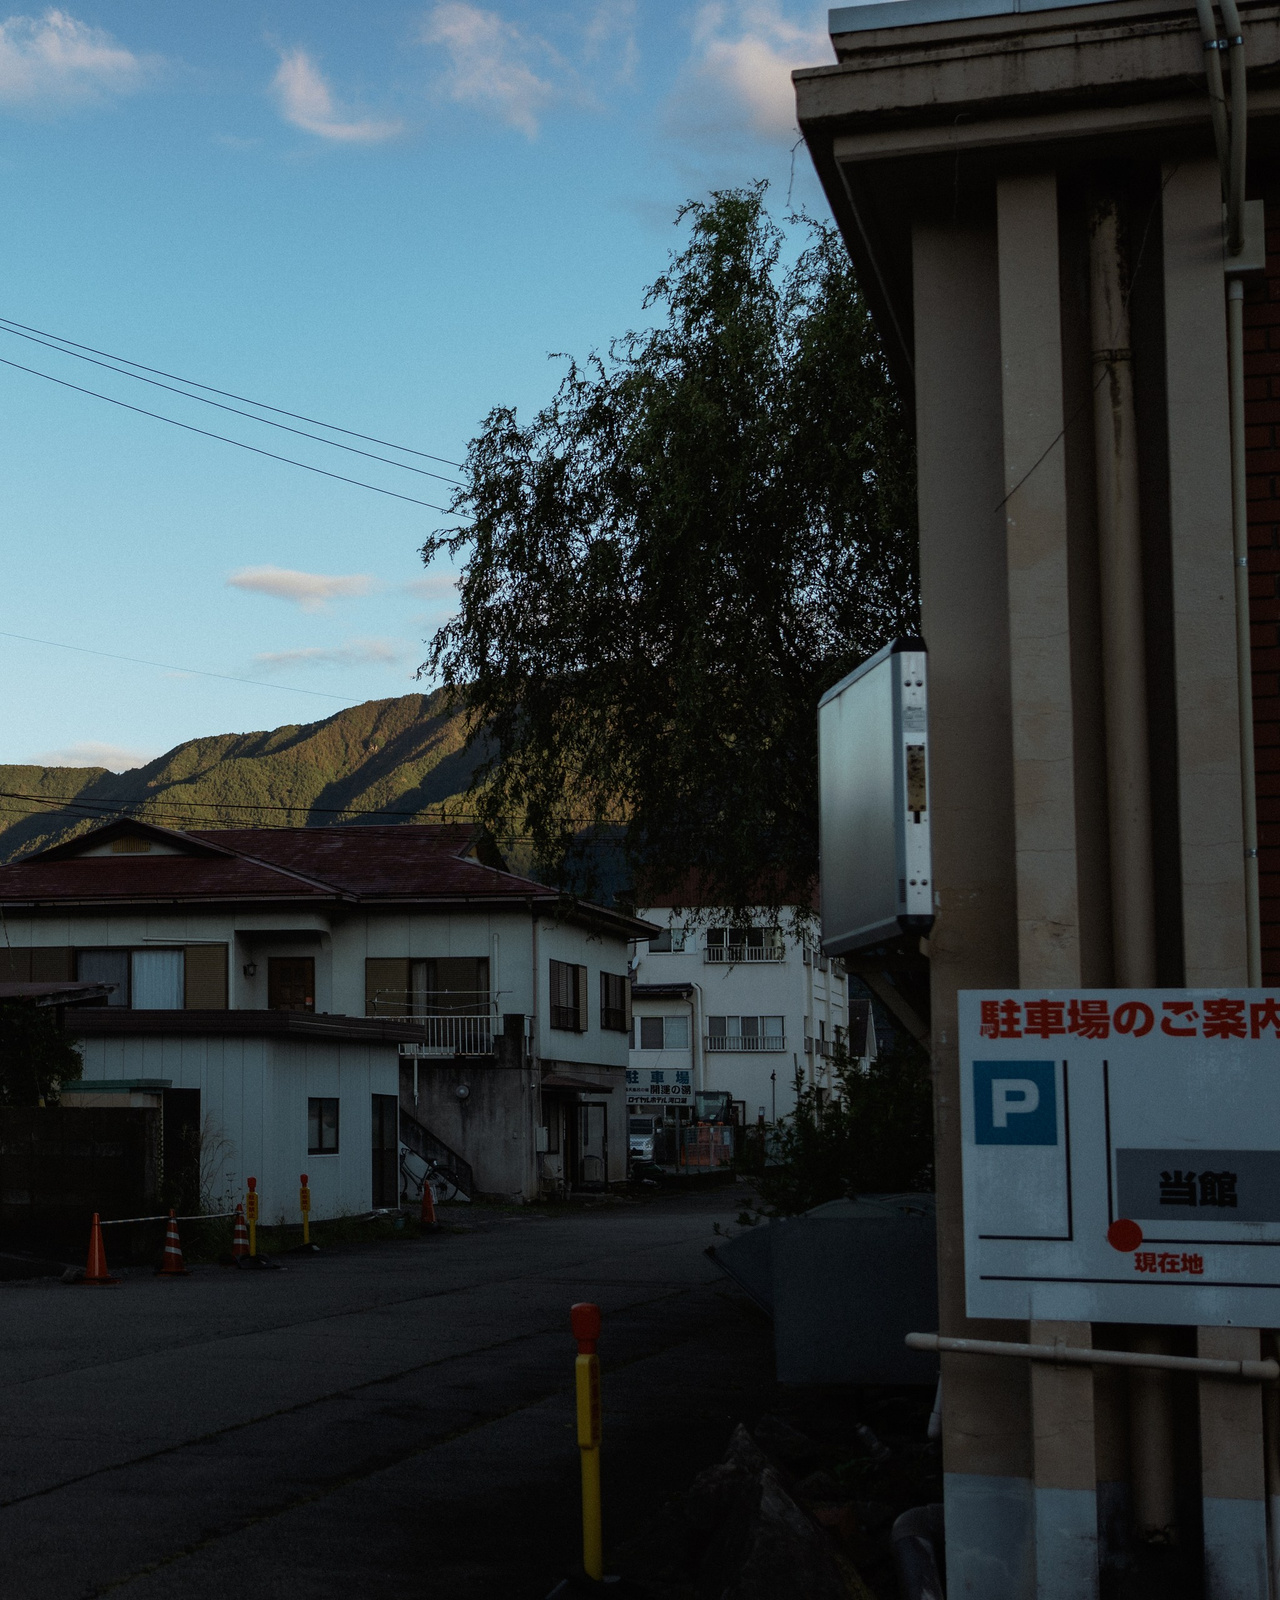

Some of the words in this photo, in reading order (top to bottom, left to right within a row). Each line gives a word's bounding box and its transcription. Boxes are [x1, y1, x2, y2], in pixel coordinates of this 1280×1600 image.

[980, 999, 1280, 1040] 駐車場のご案内
[625, 1070, 690, 1085] 駐車場
[991, 1078, 1041, 1128] P
[1159, 1171, 1238, 1208] 当館
[1134, 1252, 1204, 1274] 現在地
